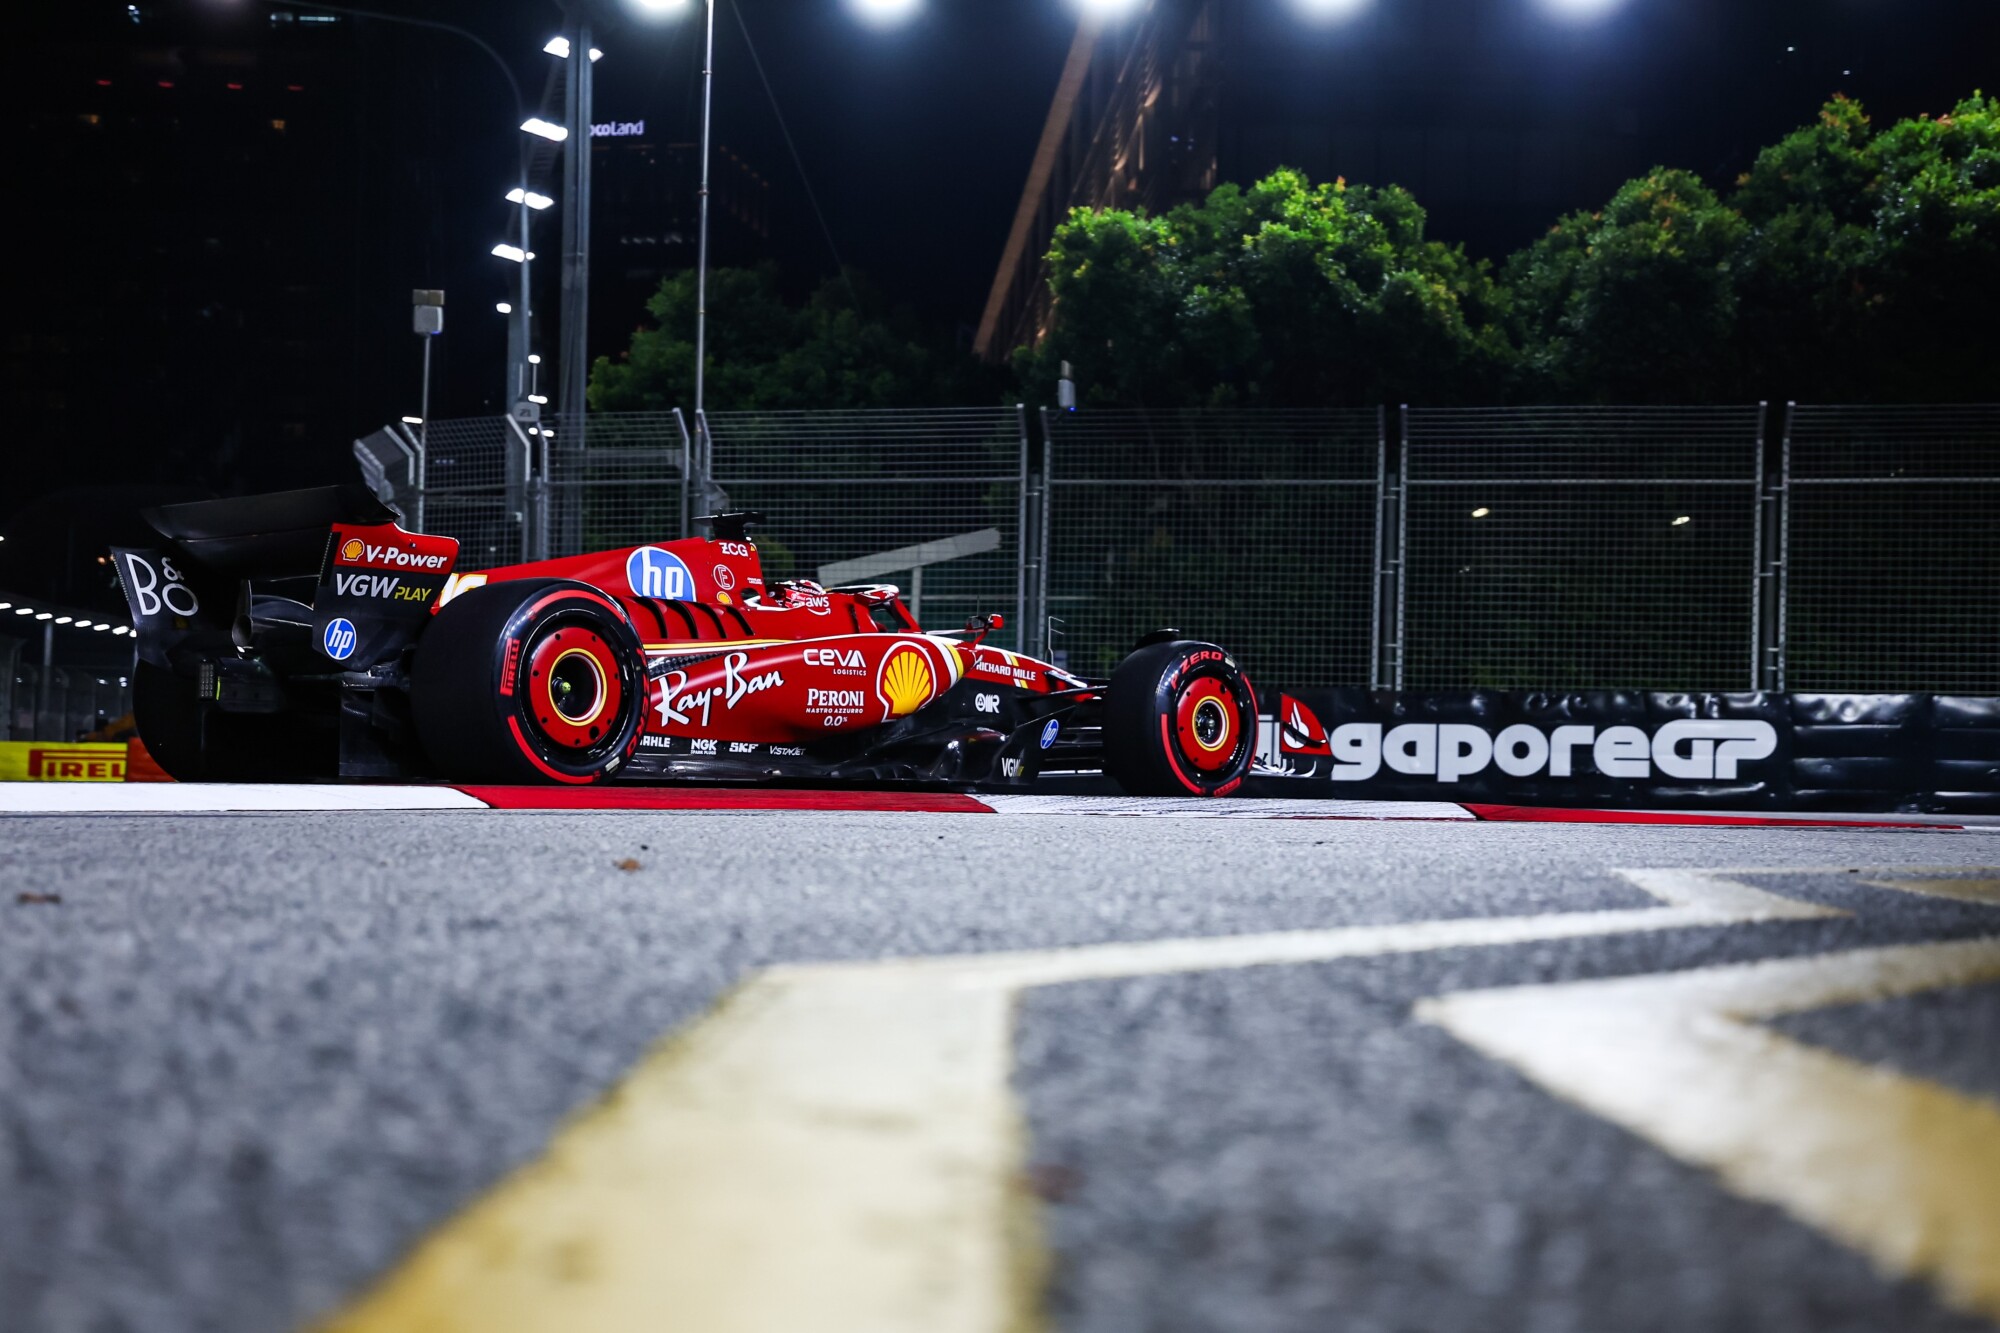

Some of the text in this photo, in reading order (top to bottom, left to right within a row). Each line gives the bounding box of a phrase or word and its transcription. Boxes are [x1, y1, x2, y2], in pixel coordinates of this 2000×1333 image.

[365, 544, 448, 569] V-Power
[718, 542, 748, 557] ZCG
[638, 547, 687, 601] hp
[335, 572, 434, 603] VGW PLAY
[805, 596, 830, 608] aws
[326, 618, 355, 660] hp
[499, 637, 521, 697] PIRELLI
[976, 661, 1036, 681] RICHARD MILLE
[1179, 650, 1224, 674] ZERO
[833, 668, 867, 677] LOGISTICS
[807, 688, 864, 706] PERONI
[691, 738, 718, 751] NGK
[728, 742, 759, 753] SKF
